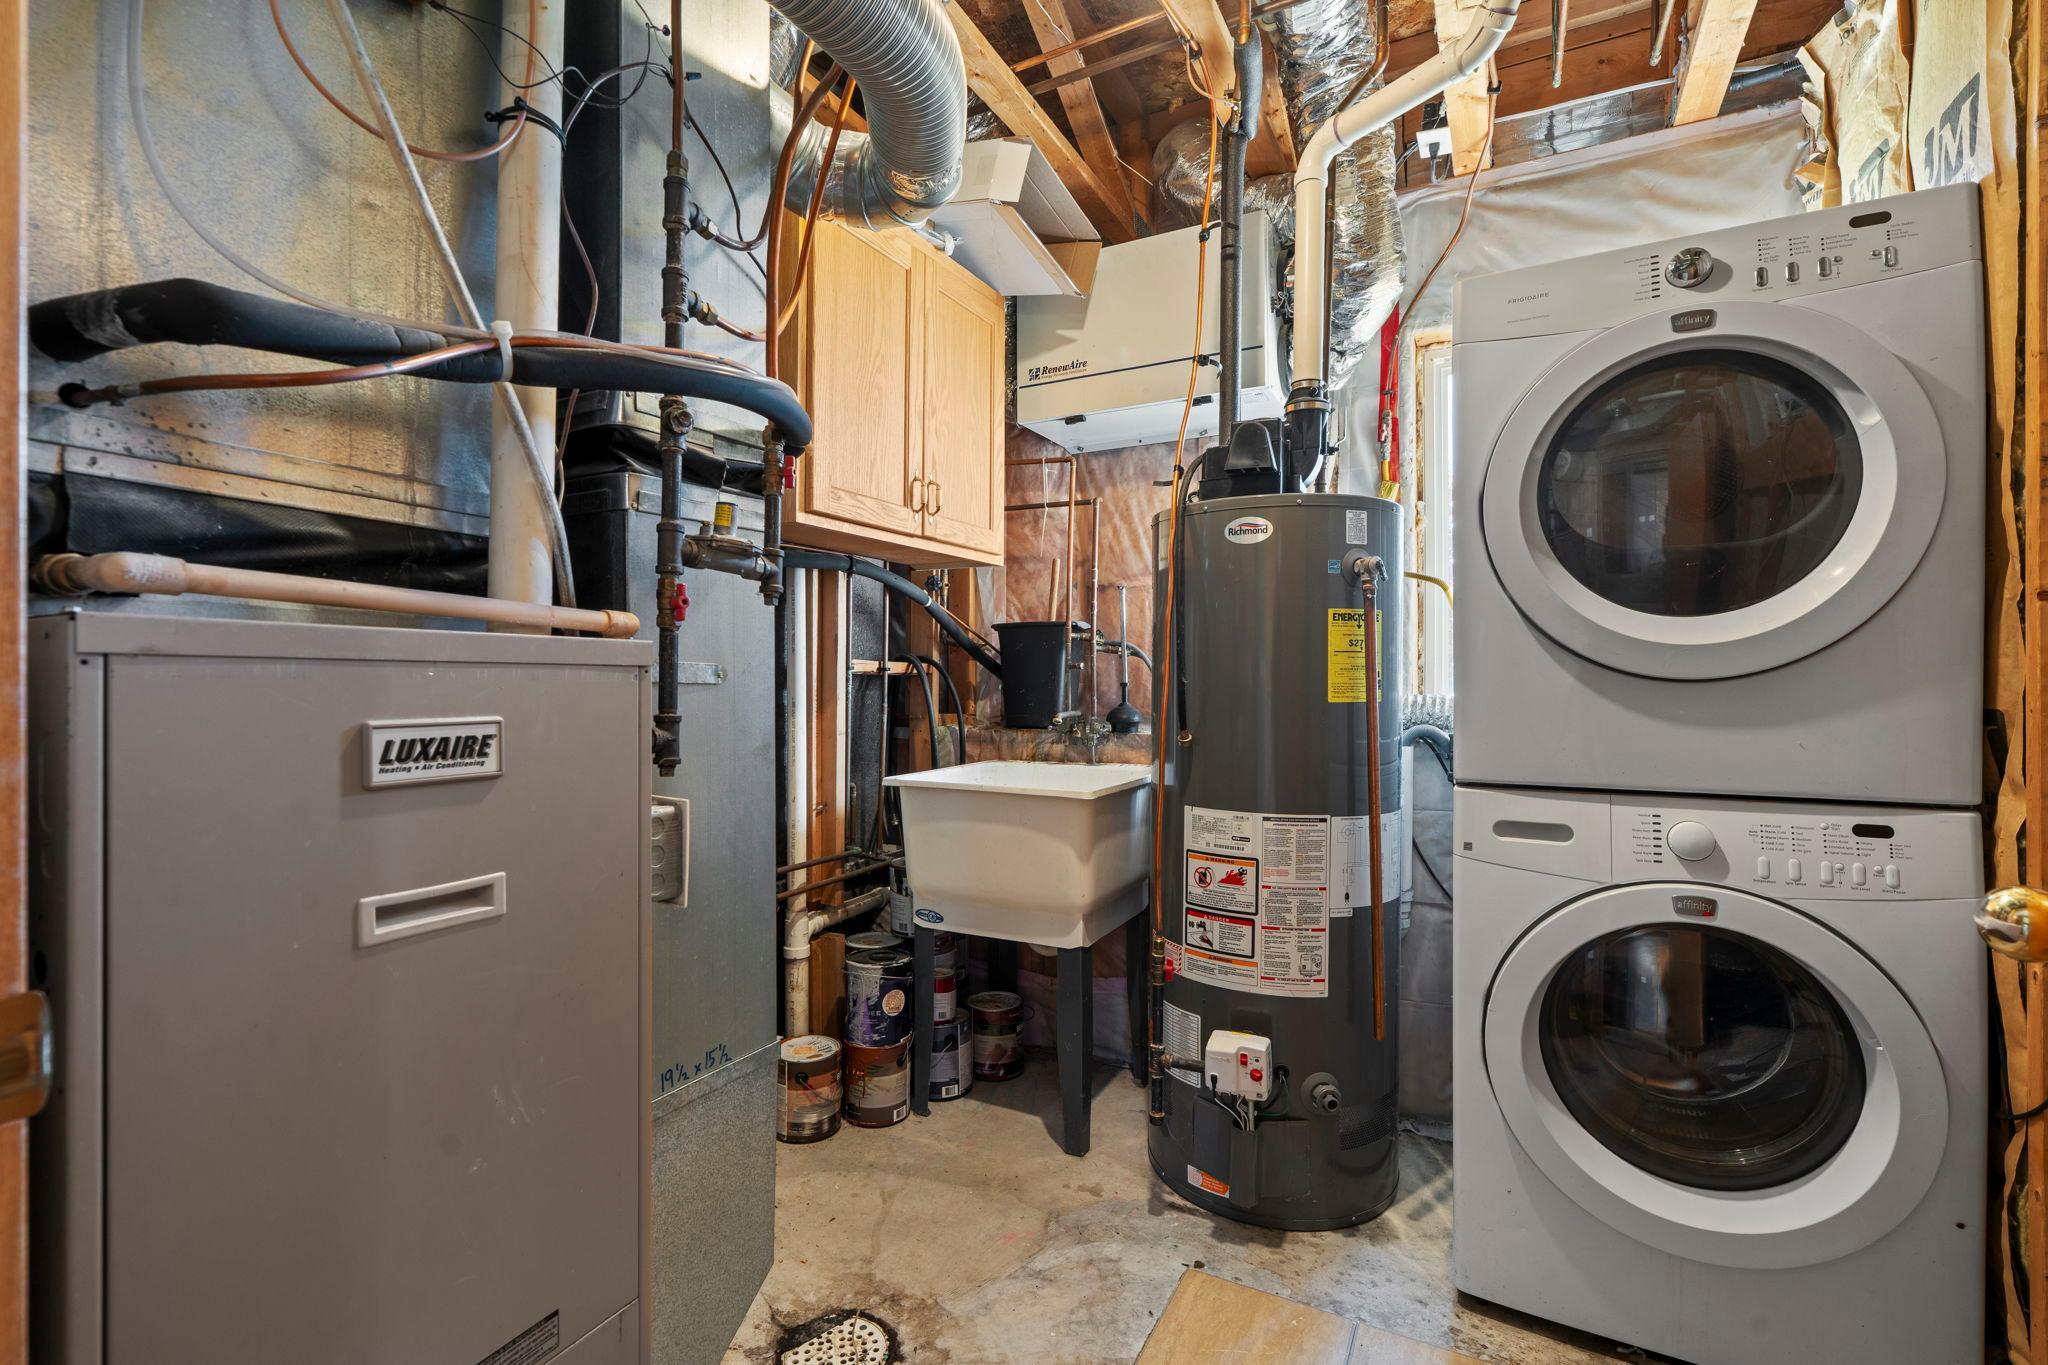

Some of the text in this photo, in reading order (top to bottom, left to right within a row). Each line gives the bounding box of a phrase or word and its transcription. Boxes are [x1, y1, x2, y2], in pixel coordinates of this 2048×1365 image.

[1507, 292, 1550, 305] FRIGIDAIRE
[1674, 314, 1710, 326] affinity
[1041, 359, 1088, 375] RenewAire
[1228, 525, 1268, 536] Richmond
[378, 734, 497, 766] LUXAIRE
[378, 759, 486, 775] Heating Air Conditioning
[1677, 899, 1713, 912] affinity
